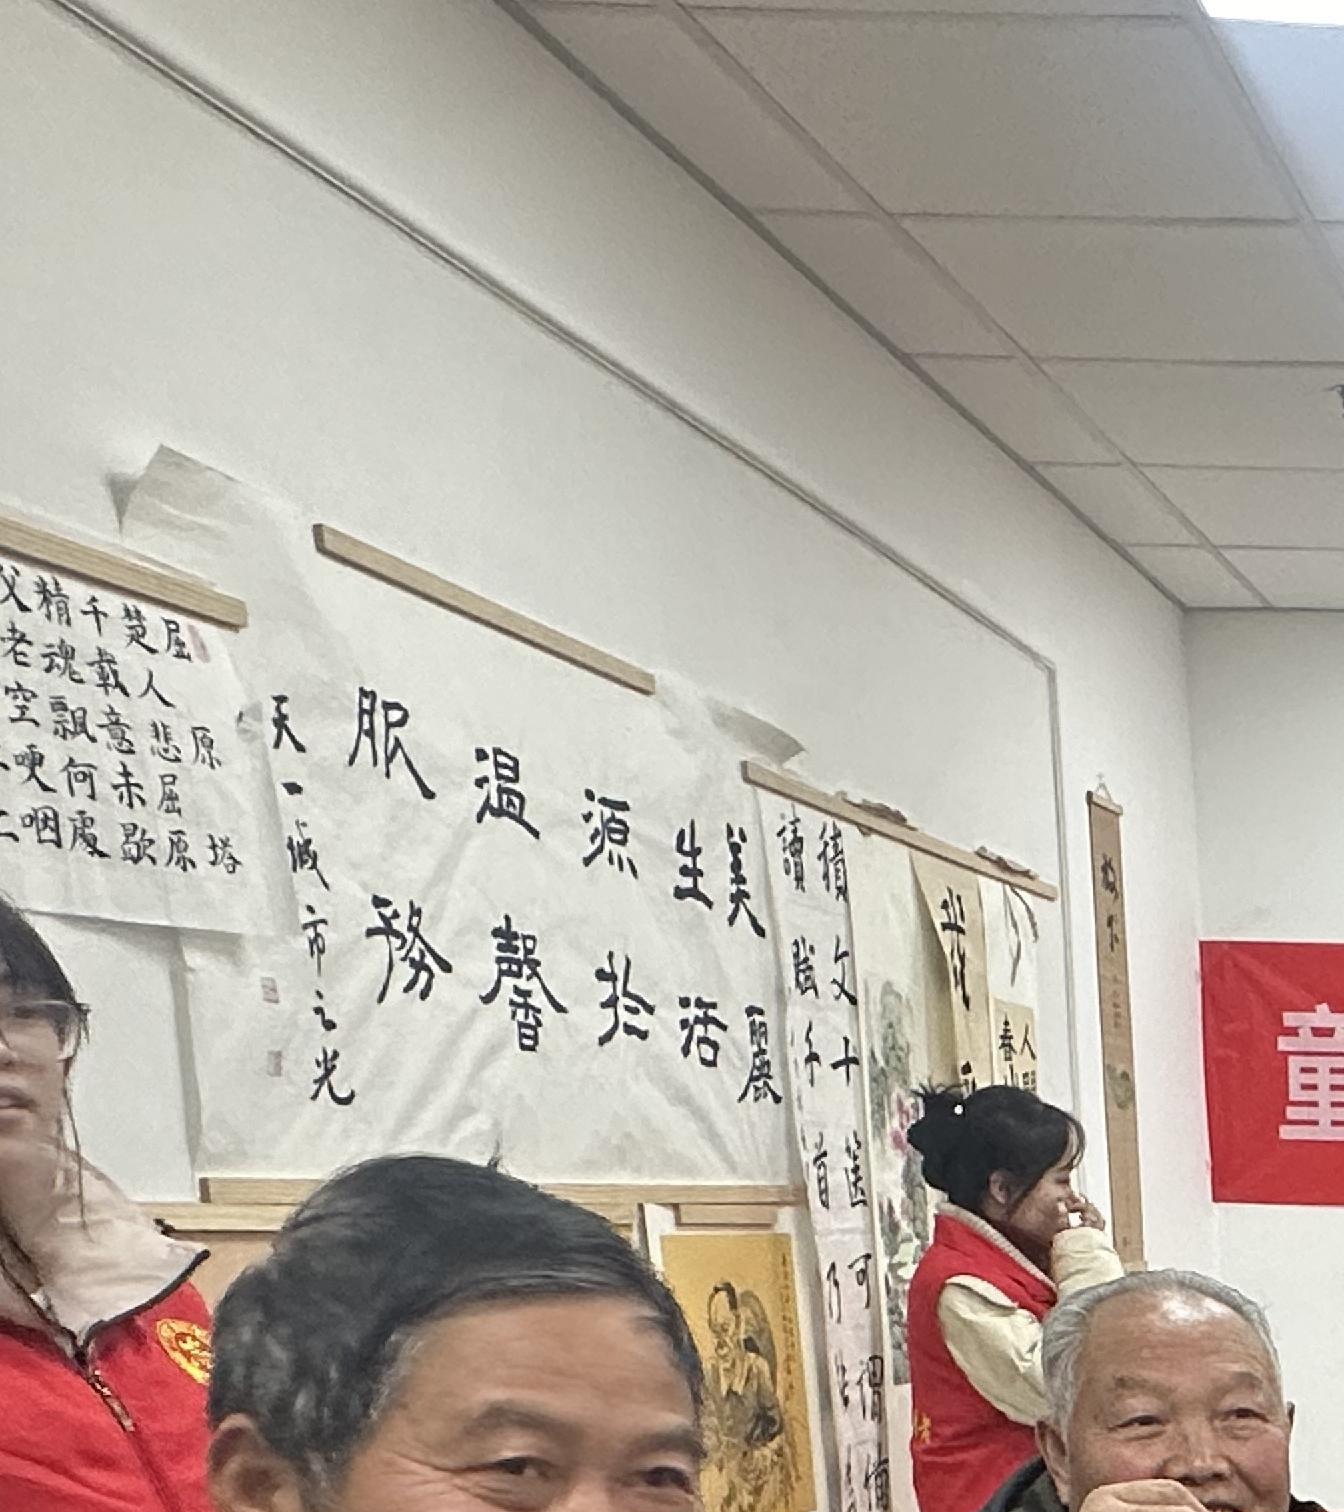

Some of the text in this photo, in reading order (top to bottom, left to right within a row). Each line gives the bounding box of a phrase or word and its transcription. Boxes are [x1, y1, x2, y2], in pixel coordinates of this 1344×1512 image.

[122, 602, 197, 873] 楚人悲屈原
